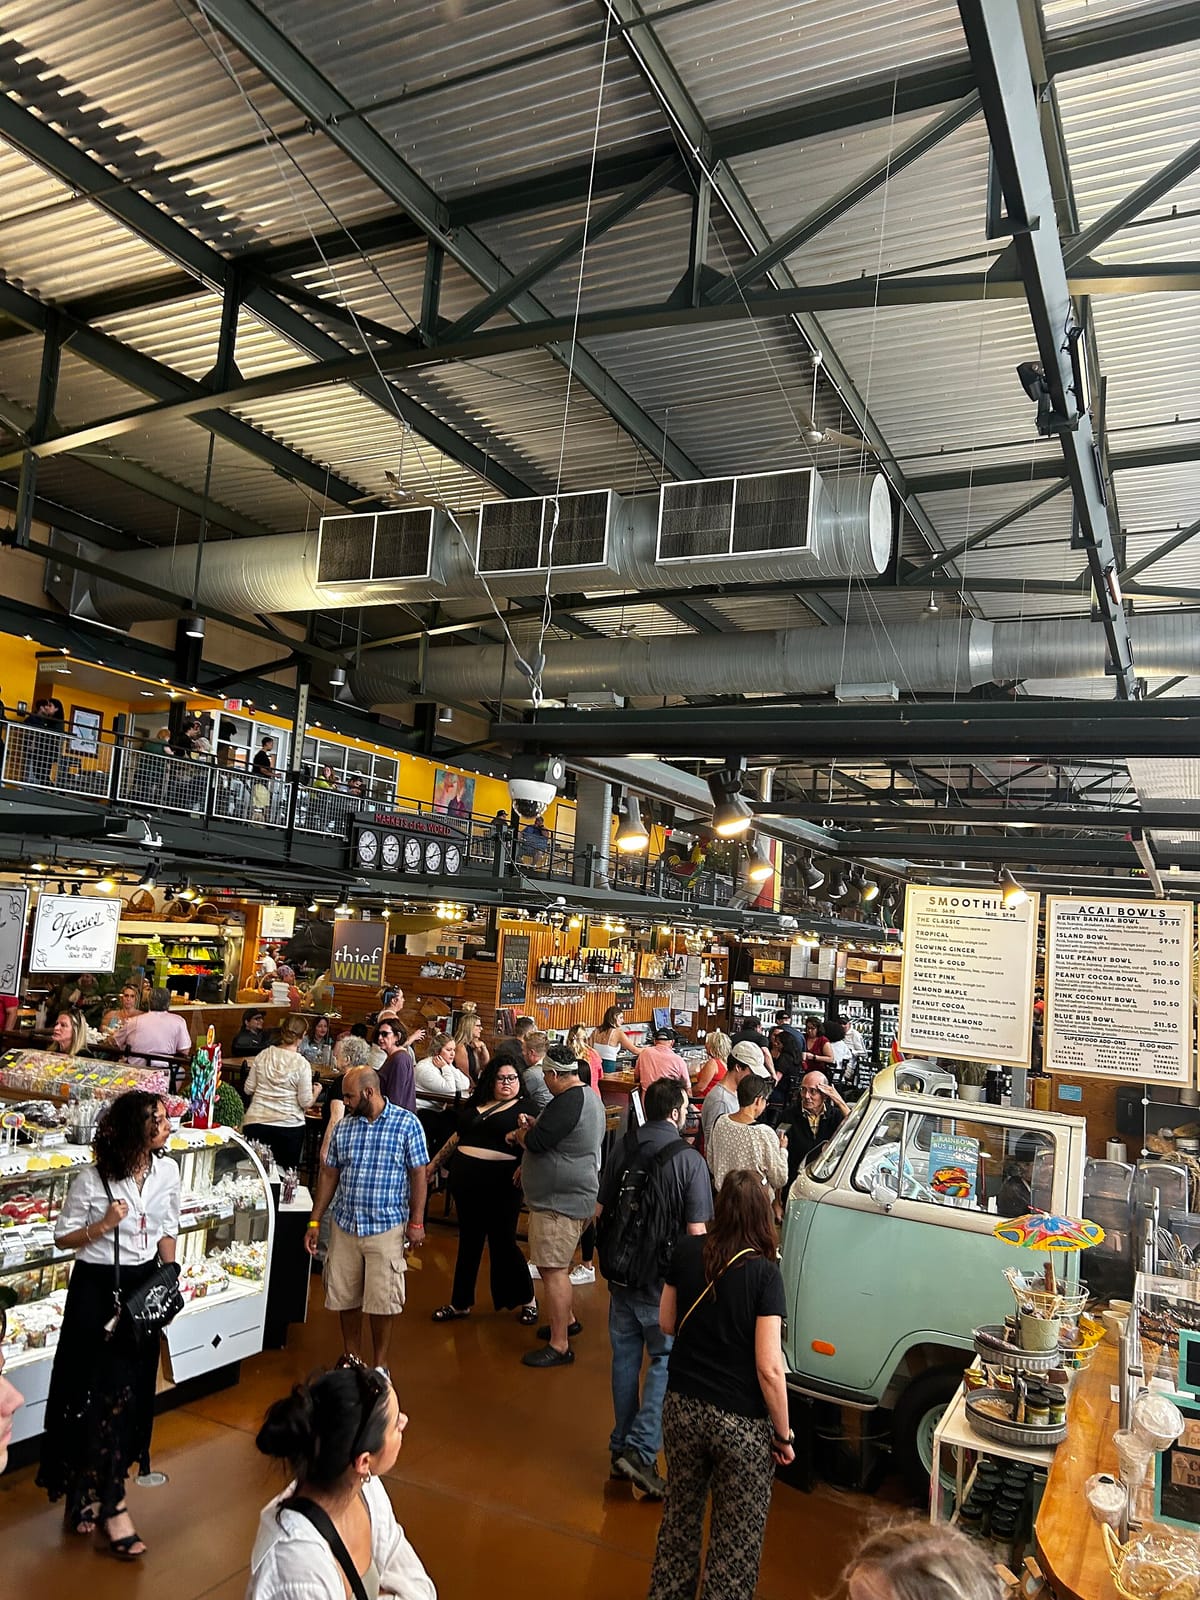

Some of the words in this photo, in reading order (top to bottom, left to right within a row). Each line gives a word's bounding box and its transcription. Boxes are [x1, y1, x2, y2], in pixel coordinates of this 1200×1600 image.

[374, 813, 408, 828] MARKETS
[428, 823, 452, 835] WORLD
[1078, 906, 1110, 915] ACAI
[1118, 908, 1166, 917] BOWLS
[334, 944, 382, 964] thief
[334, 962, 380, 982] WINE
[912, 1013, 950, 1022] BLUEBERRY
[911, 1028, 944, 1037] ESPRESSO
